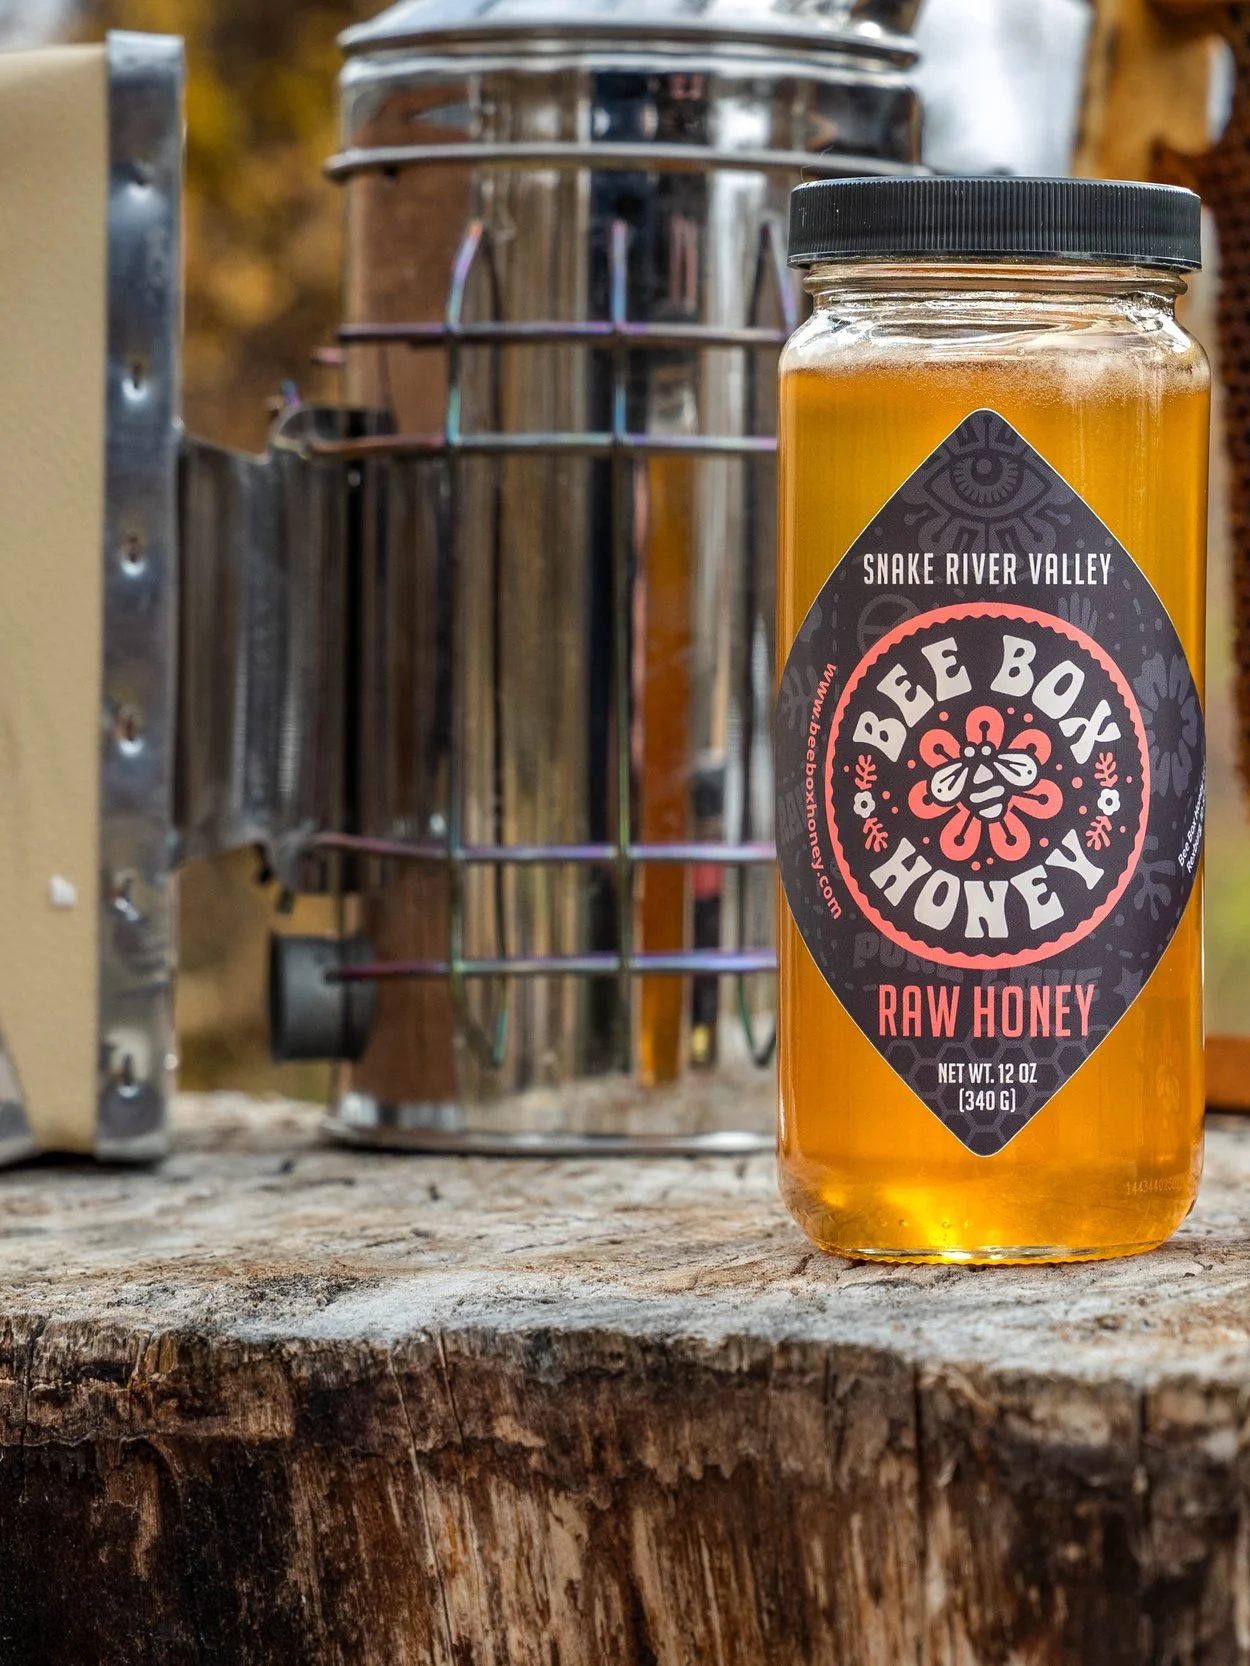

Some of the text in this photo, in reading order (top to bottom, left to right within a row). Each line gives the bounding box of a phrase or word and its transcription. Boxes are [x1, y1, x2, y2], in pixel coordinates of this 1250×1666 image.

[863, 552, 1112, 586] SNAKE RIVER VALLEY
[853, 634, 1121, 764] BEE BOX
[805, 663, 843, 920] www.beeboxhoney.com
[1177, 841, 1190, 867] Bee
[869, 829, 1105, 938] HONEY
[879, 984, 1094, 1038] RAW HONEY
[938, 1062, 1038, 1084] NET WT. 12 OZ
[959, 1087, 1016, 1113] (340 G)
